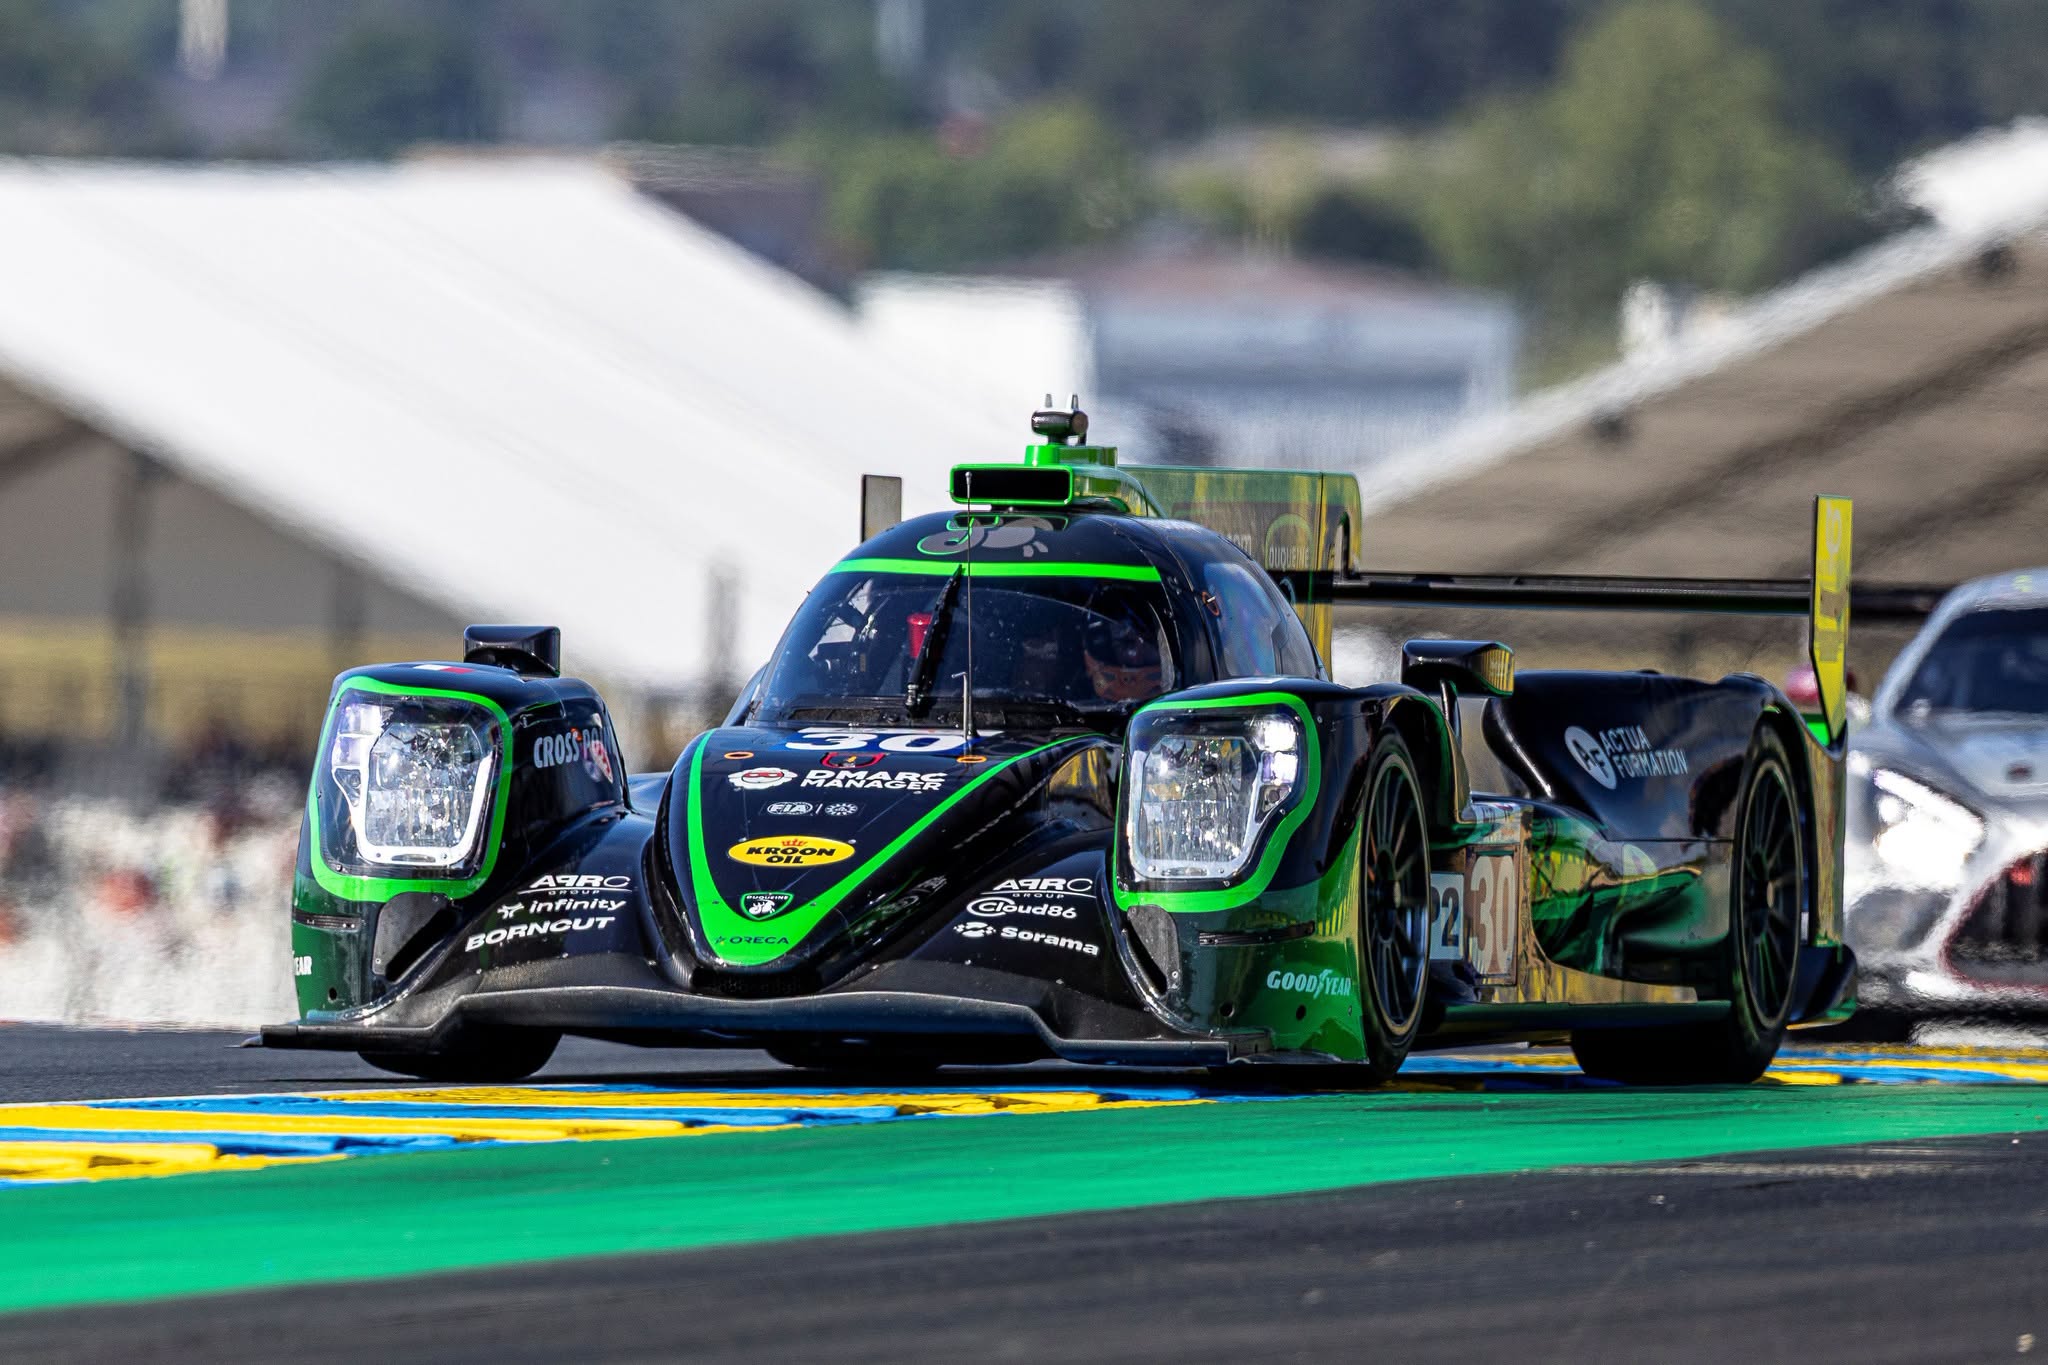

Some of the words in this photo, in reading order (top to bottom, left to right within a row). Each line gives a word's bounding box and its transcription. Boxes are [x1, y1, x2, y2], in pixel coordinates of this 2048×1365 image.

[533, 731, 580, 769] CROSS
[785, 732, 968, 752] 30
[1599, 725, 1652, 756] ACTUA
[1612, 748, 1689, 778] FORMATION
[800, 778, 942, 791] MANAGER
[806, 769, 949, 783] DMARC
[746, 847, 836, 856] KROON
[766, 855, 803, 864] OIL
[529, 898, 627, 914] infinity
[978, 901, 1077, 919] Cloud86
[1470, 855, 1516, 975] 30
[465, 916, 616, 952] BORNCUT
[729, 936, 789, 945] ORECA
[1000, 926, 1100, 956] Sorama
[1265, 968, 1352, 999] GOODYEAR
